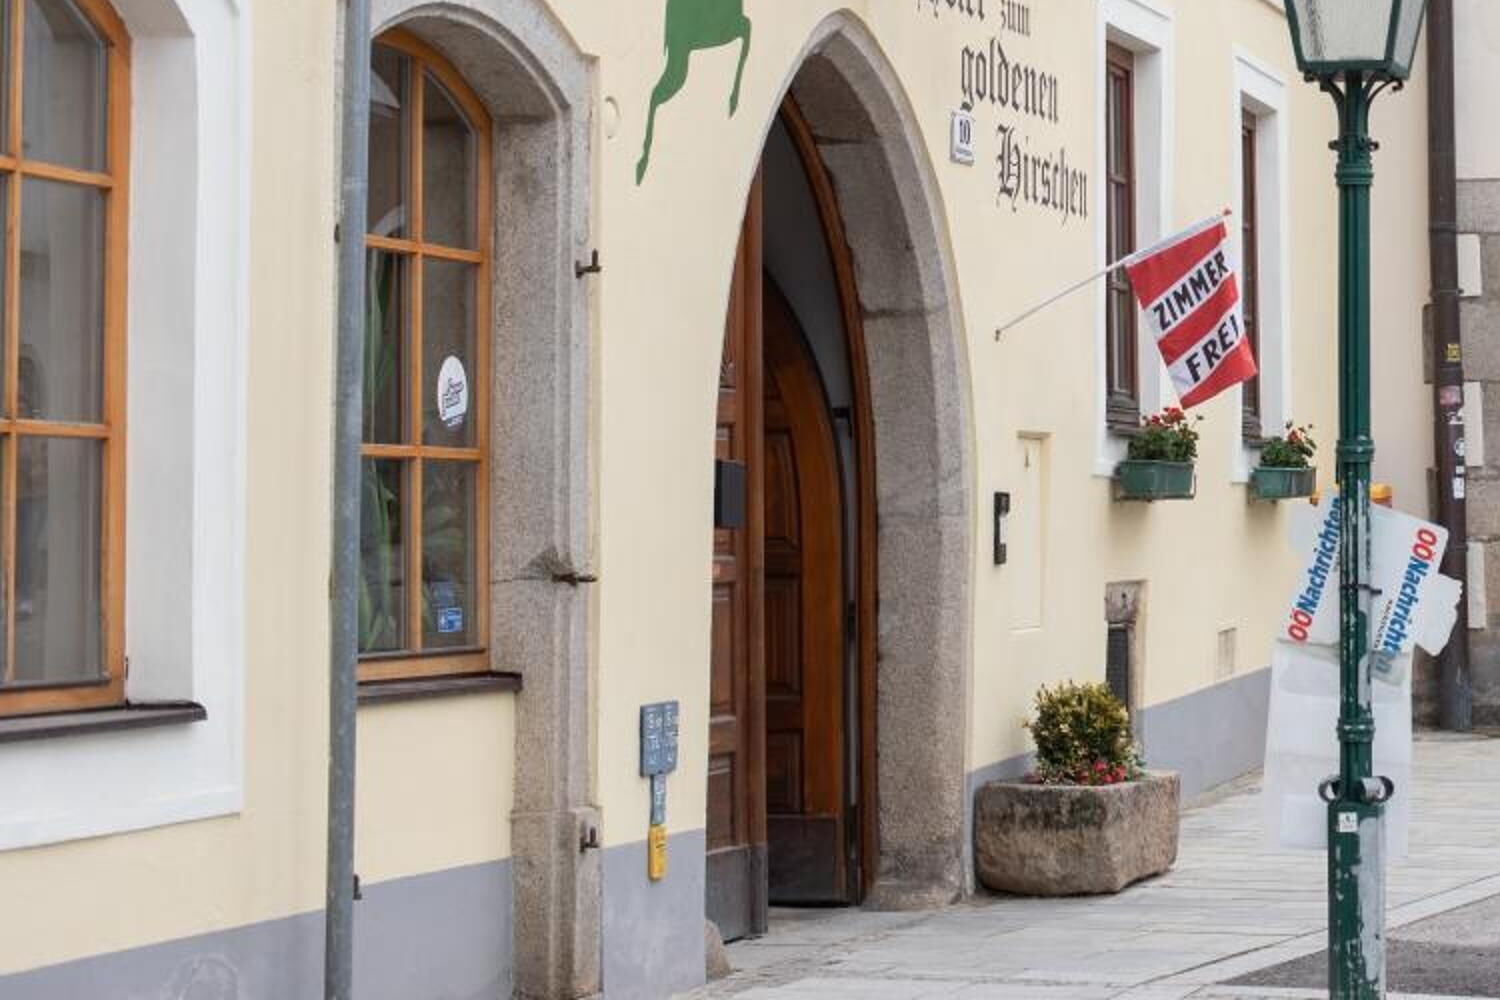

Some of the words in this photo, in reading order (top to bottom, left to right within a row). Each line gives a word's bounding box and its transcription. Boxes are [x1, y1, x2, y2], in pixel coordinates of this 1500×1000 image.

[960, 36, 1058, 124] goldenen
[996, 123, 1088, 226] Hirschen
[1153, 250, 1229, 331] ZIMMER
[1185, 314, 1239, 383] FREI
